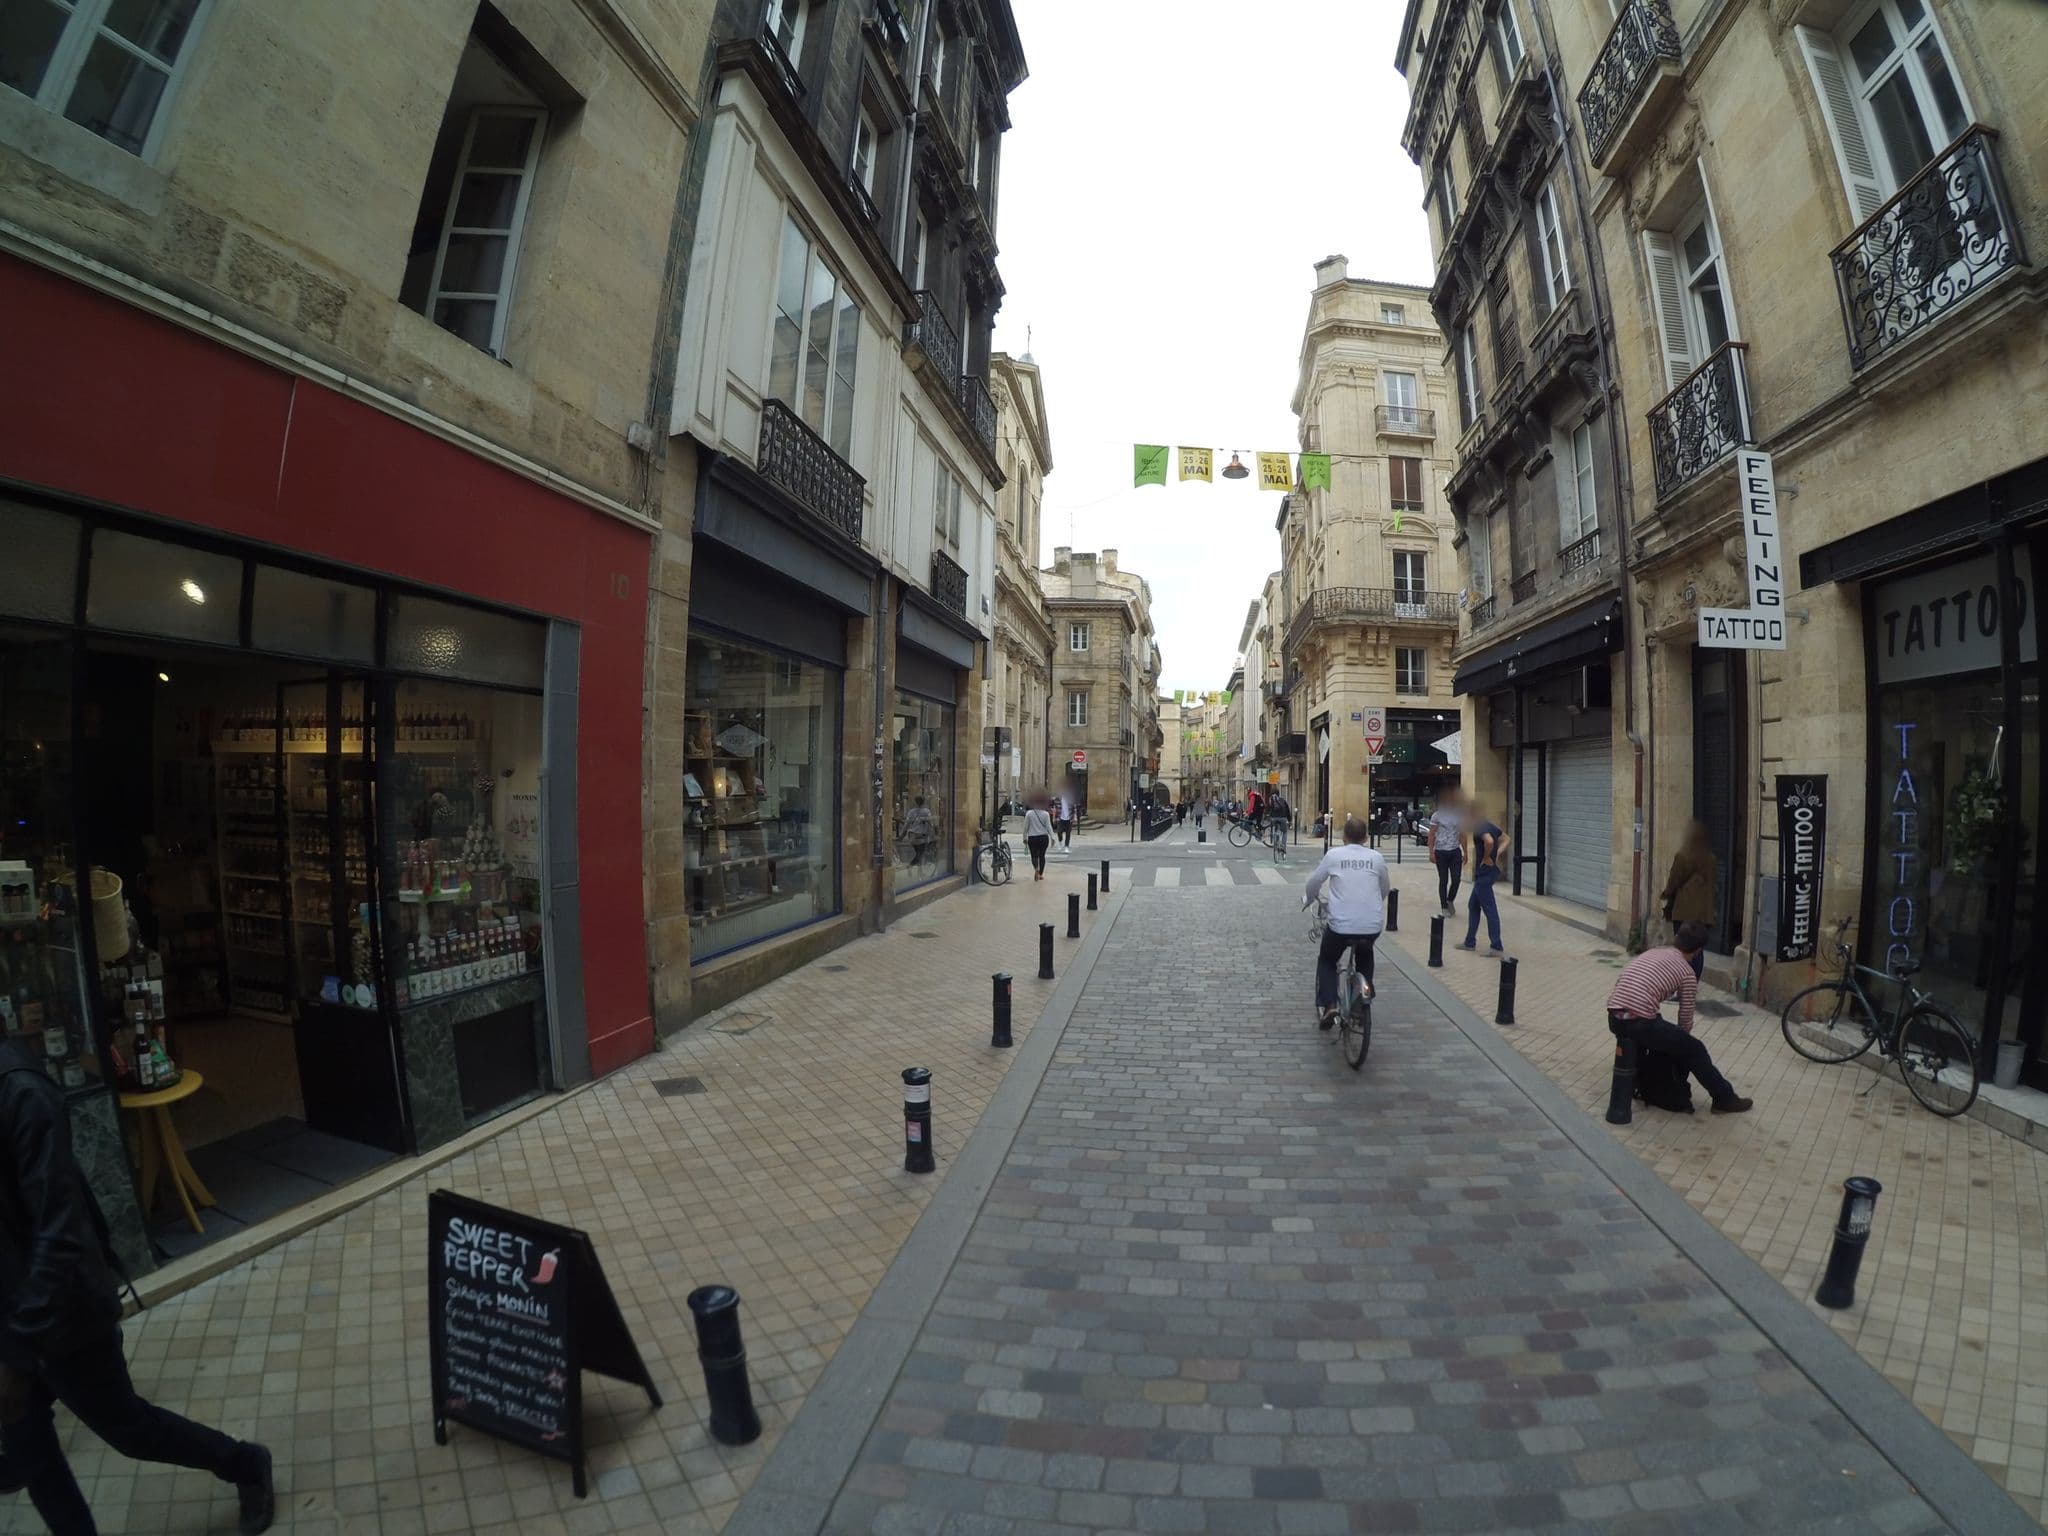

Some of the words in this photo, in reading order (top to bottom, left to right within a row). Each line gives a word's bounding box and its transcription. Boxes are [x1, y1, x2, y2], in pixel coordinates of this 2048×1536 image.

[1184, 466, 1209, 476] MAI
[1264, 475, 1288, 485] MAI
[1746, 457, 1780, 607] FEELING
[1703, 616, 1782, 642] TATTOO
[1794, 807, 1814, 875] TATTOO
[1792, 884, 1811, 945] FEELING
[447, 1217, 533, 1265] SWEET
[443, 1241, 530, 1293] PEPPER
